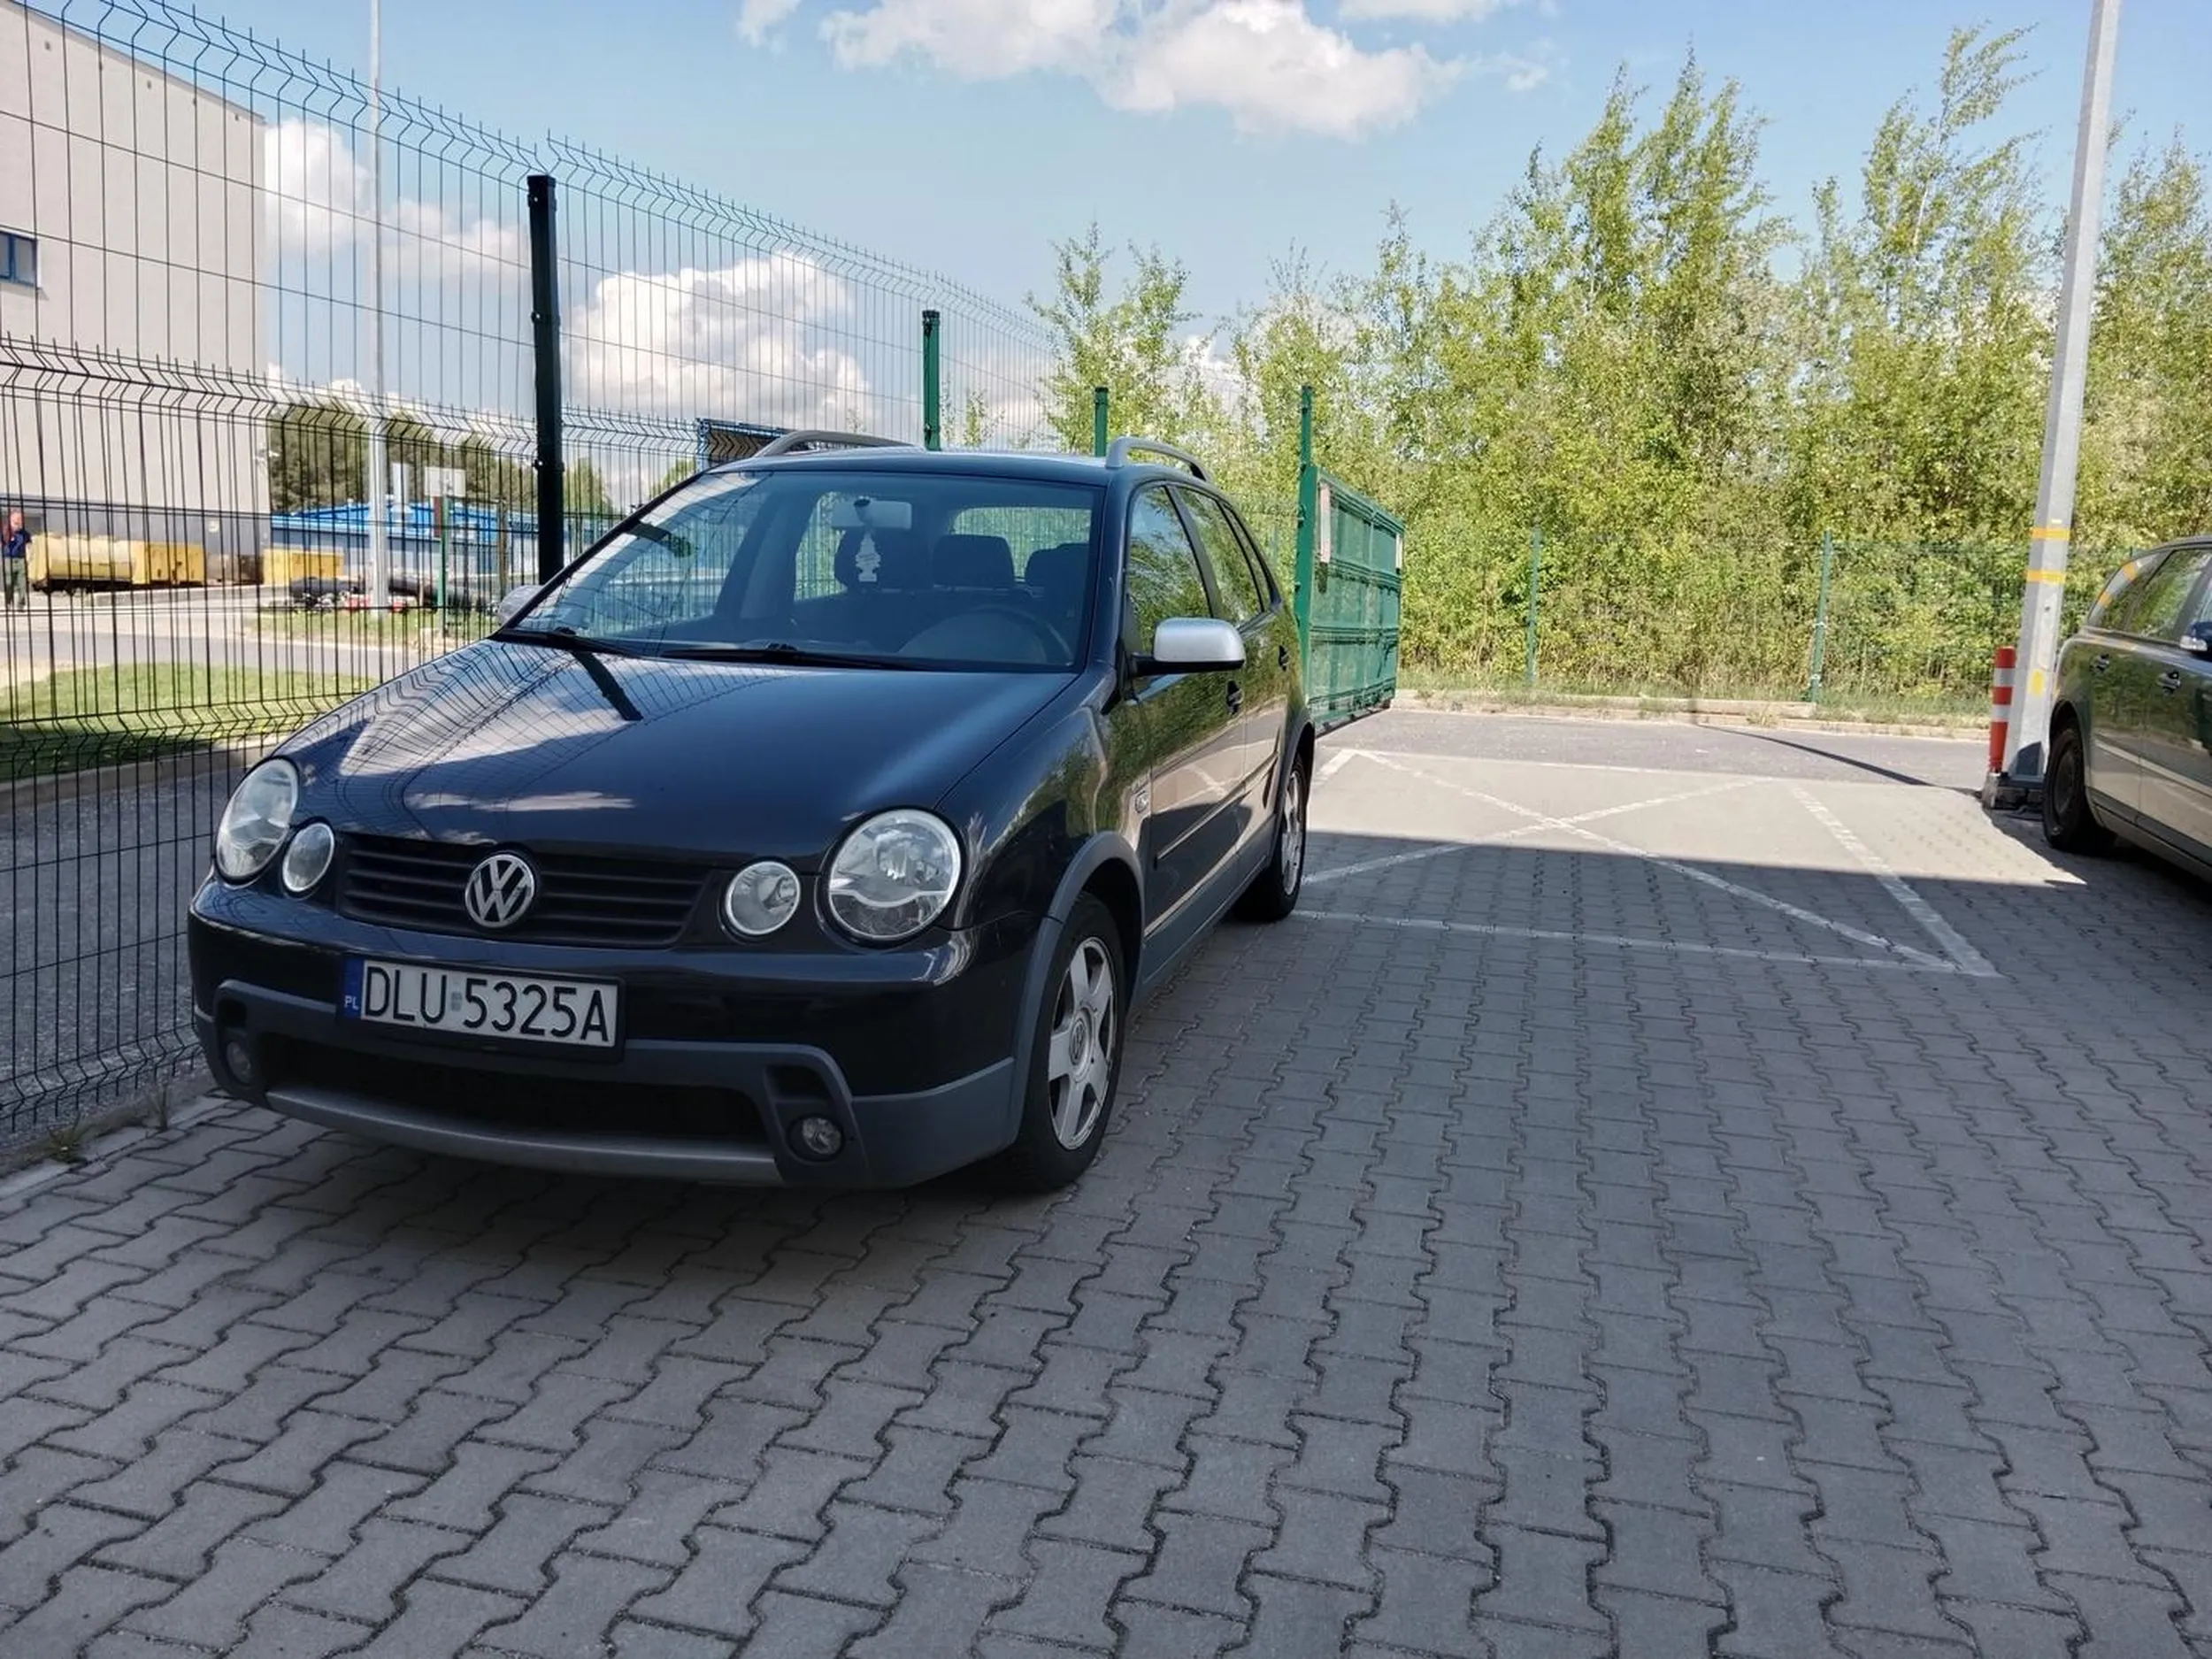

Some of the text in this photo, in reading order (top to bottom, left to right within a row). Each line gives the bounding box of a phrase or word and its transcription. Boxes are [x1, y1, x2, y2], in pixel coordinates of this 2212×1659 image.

[344, 995, 359, 1010] PL
[365, 966, 609, 1041] DLU 5325A
